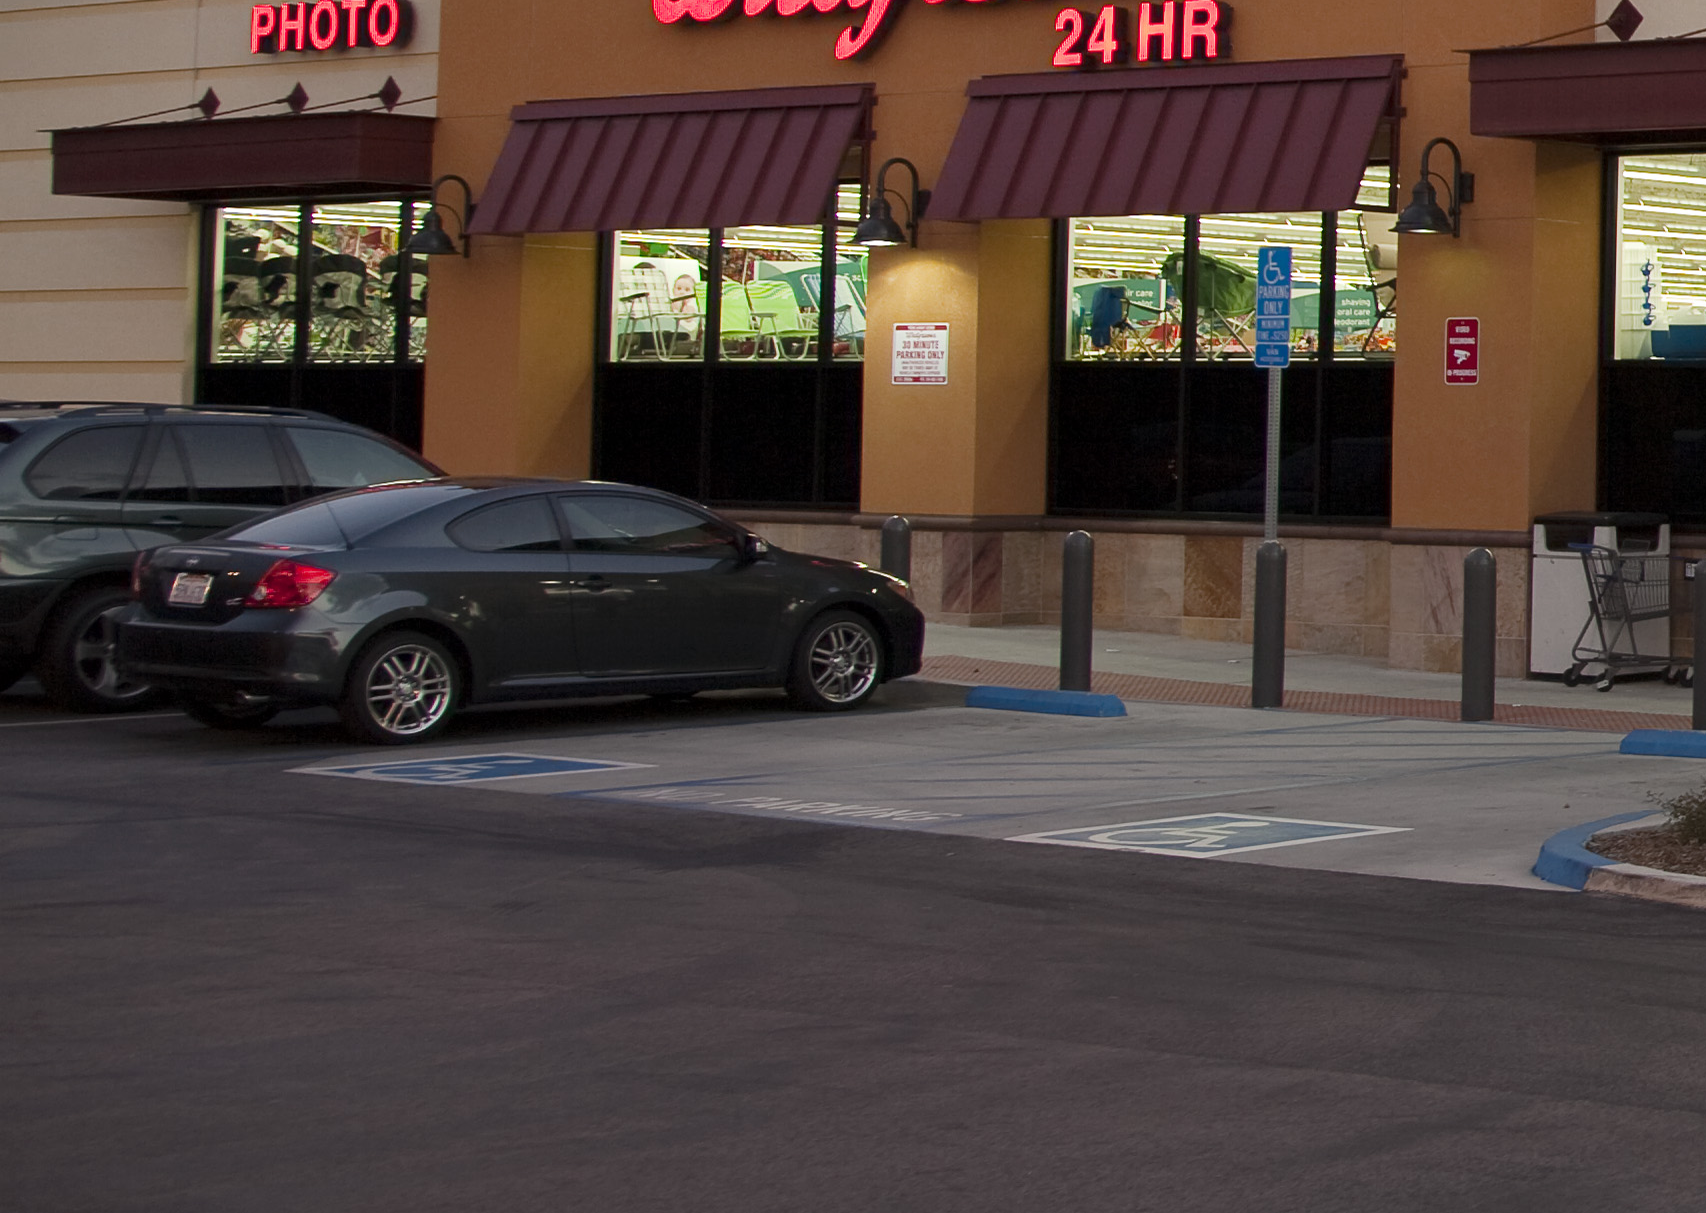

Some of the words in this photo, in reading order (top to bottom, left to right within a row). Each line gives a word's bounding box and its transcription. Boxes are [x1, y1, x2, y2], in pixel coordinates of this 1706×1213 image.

[1053, 5, 1117, 66] 24
[1136, 290, 1154, 298] care
[1259, 285, 1289, 299] PARKING
[1341, 298, 1371, 307] shaving
[1263, 300, 1284, 315] ONLY
[1337, 308, 1353, 316] oral
[1334, 318, 1371, 326] eodorant
[902, 340, 911, 349] 30
[913, 340, 940, 349] MINUTE
[896, 350, 926, 359] PARKING
[927, 350, 945, 359] ONLY
[709, 796, 964, 822] PARKING
